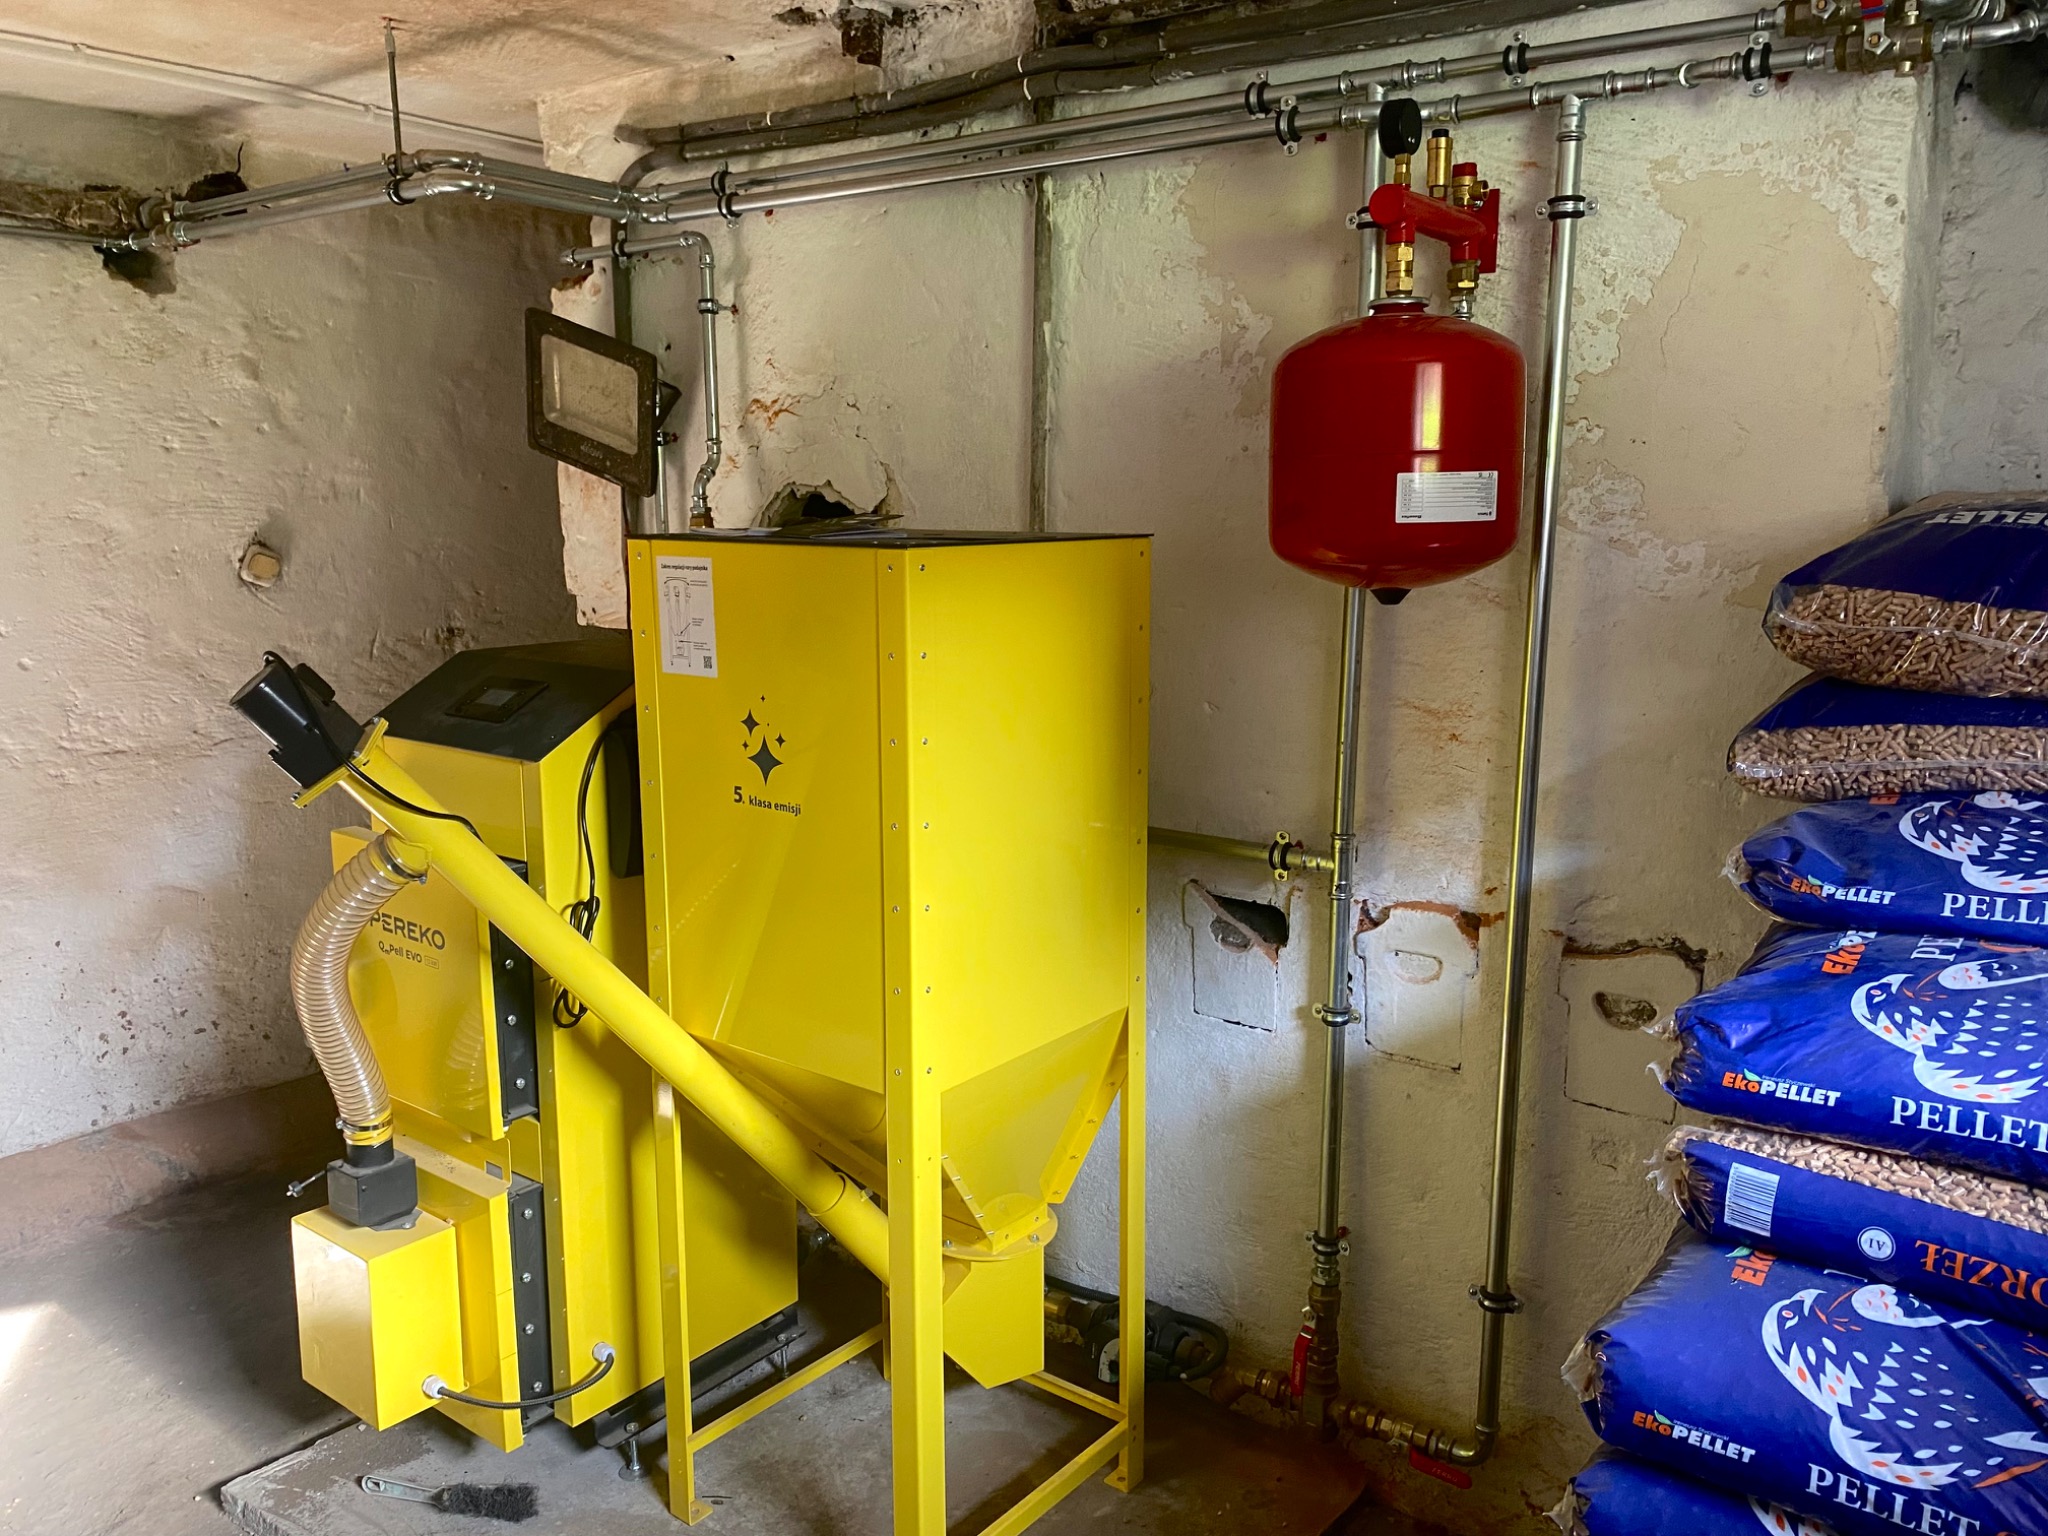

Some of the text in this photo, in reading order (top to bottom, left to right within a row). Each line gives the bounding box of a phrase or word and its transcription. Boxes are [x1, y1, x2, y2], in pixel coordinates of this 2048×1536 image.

[733, 785, 801, 817] 5. klasa emisji
[370, 911, 446, 951] PEREKO
[405, 949, 423, 963] EVO
[1890, 1096, 2048, 1154] PELLET
[1805, 1463, 1980, 1536] PELLET
